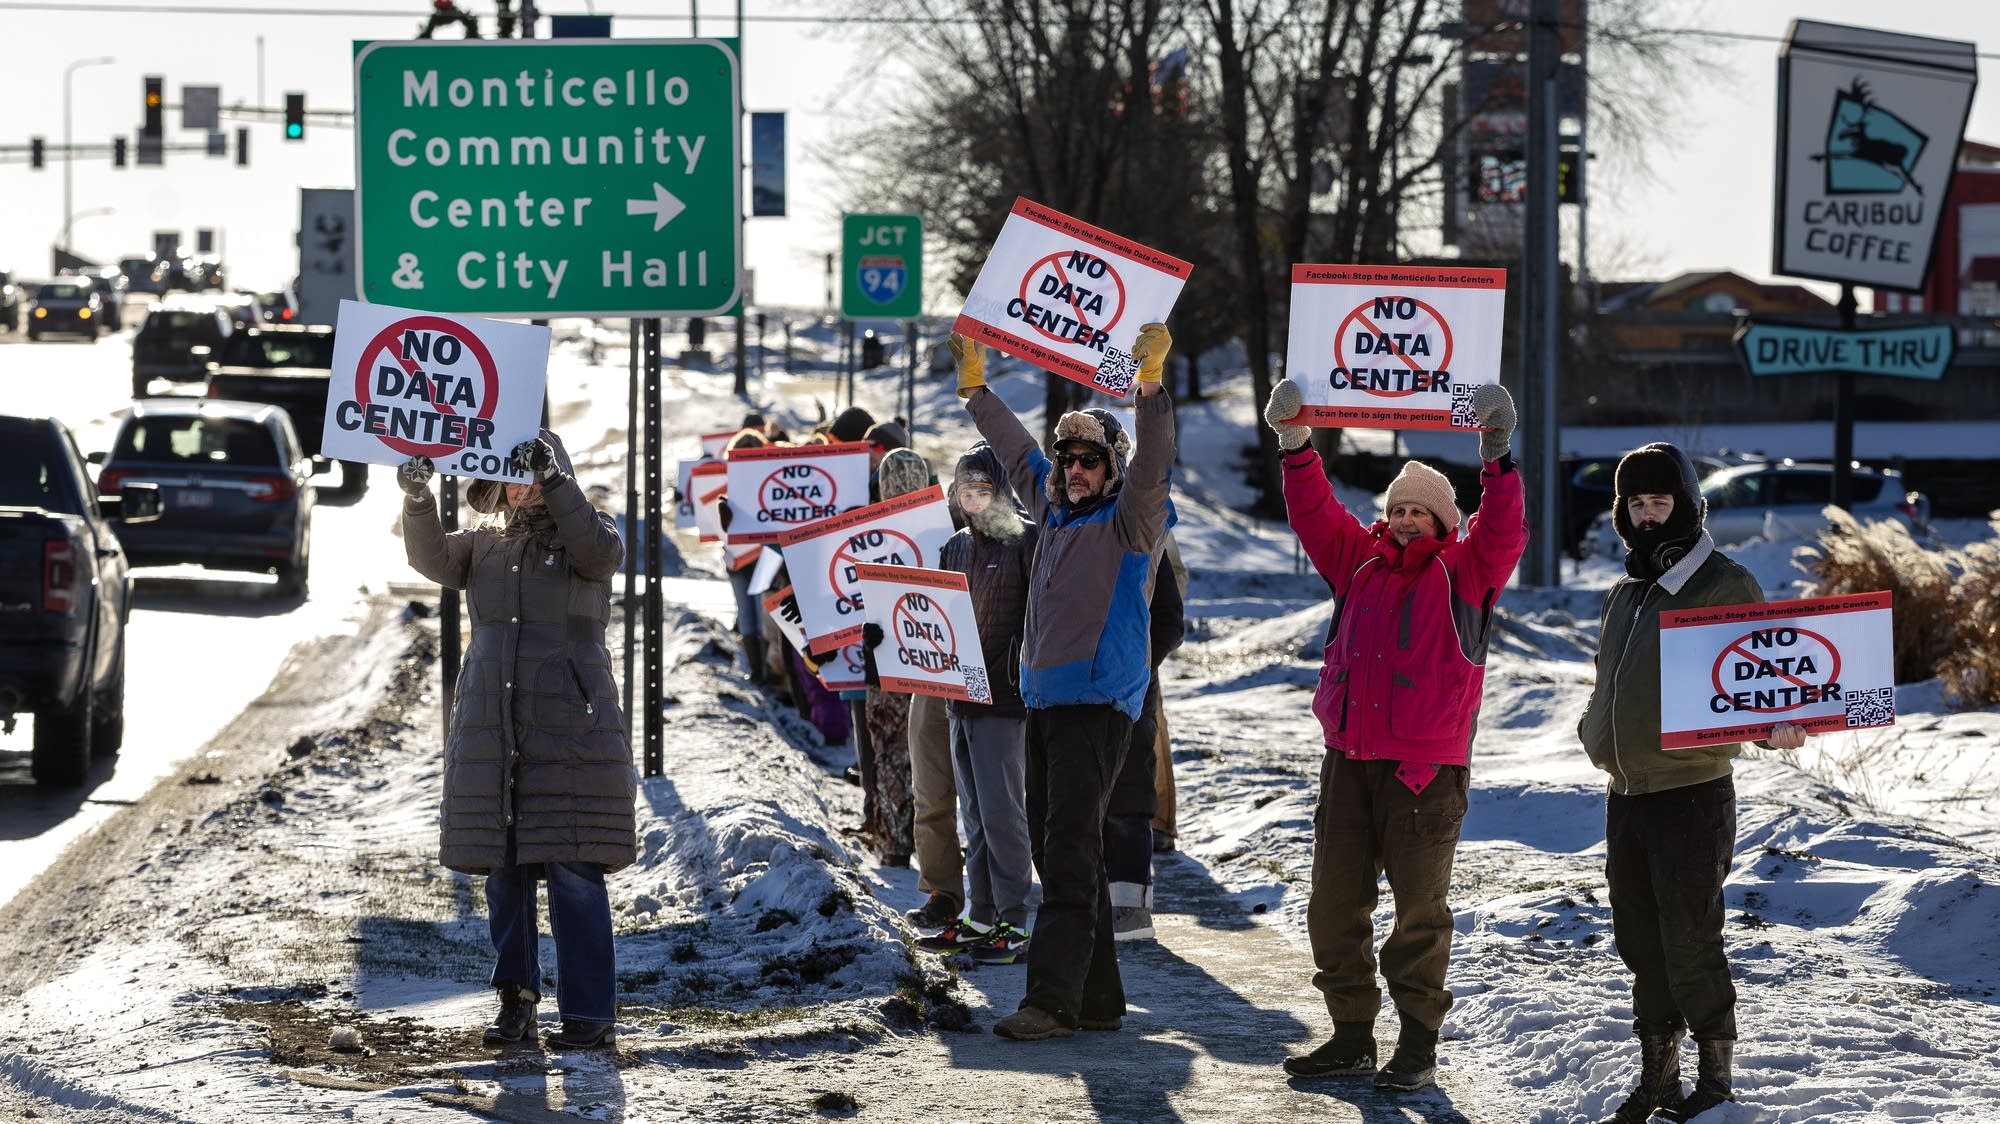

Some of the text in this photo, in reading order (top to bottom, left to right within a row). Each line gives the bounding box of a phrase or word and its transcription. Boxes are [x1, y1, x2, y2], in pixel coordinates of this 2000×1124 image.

[403, 69, 689, 107] Monticello
[387, 127, 706, 174] Community
[410, 190, 592, 228] Center
[1804, 201, 1925, 228] CARIBOU
[859, 226, 907, 246] JCT
[1024, 207, 1180, 273] Facebook: Stop the Monticello Data Centers
[1806, 228, 1912, 264] COFFEE
[392, 250, 707, 299] & City Hall
[1066, 250, 1107, 279] NO
[1306, 271, 1494, 284] Facebook: Stop the Monticello Data Centers
[864, 270, 899, 293] 94
[1038, 275, 1104, 316] DATA
[1374, 297, 1416, 320] NO
[1006, 298, 1110, 353] CENTER
[401, 330, 462, 366] NO
[982, 328, 1000, 340] Scan
[1002, 335, 1020, 347] here
[1030, 348, 1046, 358] sign
[1048, 354, 1060, 364] the
[1061, 360, 1090, 376] petition
[1355, 332, 1430, 356] DATA
[1757, 336, 1941, 368] DRIVE THRU
[376, 365, 477, 409] DATA
[1330, 367, 1450, 393] CENTER
[336, 400, 495, 450] CENTER
[1314, 409, 1444, 422] Scan here to sign the petition
[450, 452, 525, 478] .COM
[783, 465, 811, 479] NO
[772, 486, 822, 501] DATA
[757, 504, 836, 522] CENTER
[825, 520, 840, 530] Stop
[855, 507, 890, 521] Monticello
[891, 502, 907, 510] Data
[908, 494, 934, 506] Centers
[849, 530, 884, 553] NO
[906, 592, 929, 612] NO
[1674, 614, 1722, 624] Facebook:
[1726, 612, 1746, 621] Stop
[1767, 605, 1816, 616] Monticello
[1818, 603, 1840, 612] Data
[1842, 600, 1879, 609] Centers
[834, 628, 862, 641] Scan he
[904, 620, 944, 642] DATA
[1752, 627, 1798, 650] NO
[898, 647, 962, 672] CENTER
[1734, 655, 1817, 681] DATA
[1710, 682, 1842, 714] CENTER
[1697, 731, 1720, 739] Scan
[1724, 729, 1744, 737] here
[1761, 726, 1775, 735] sig
